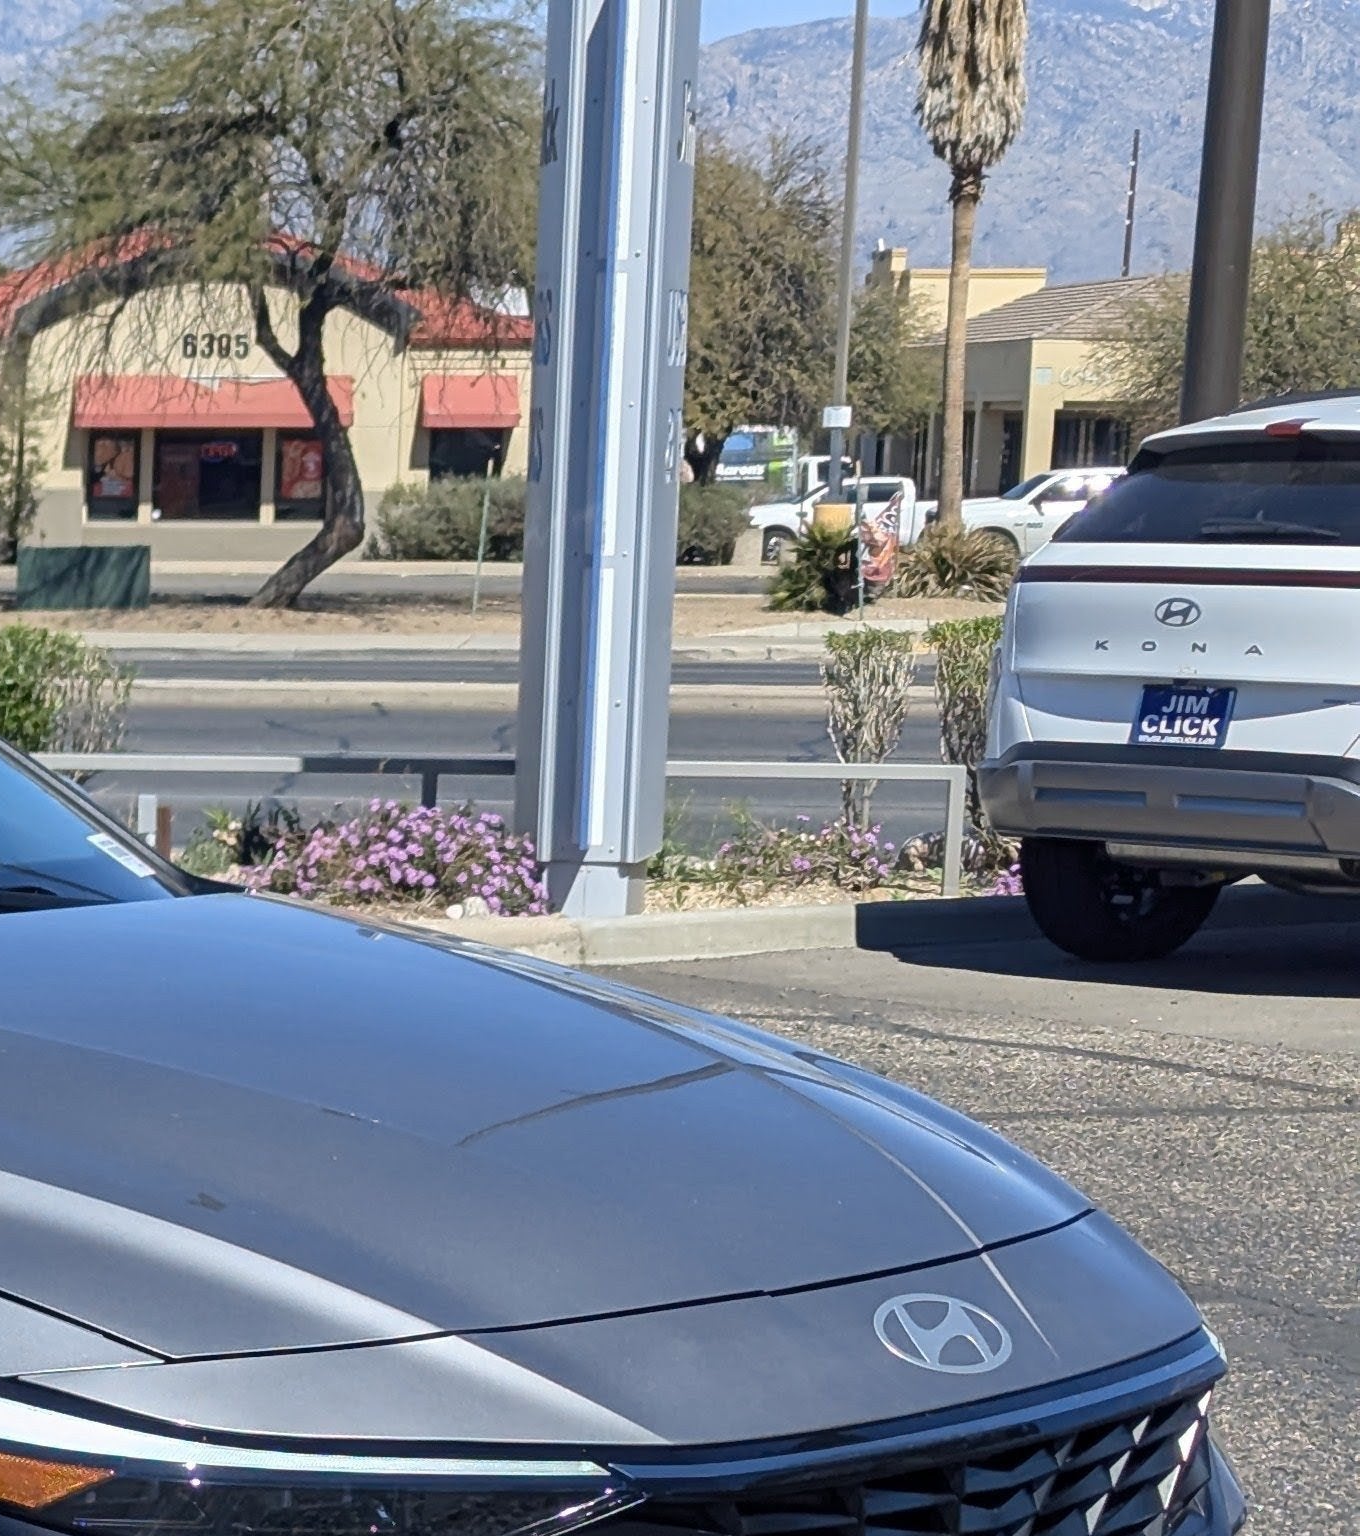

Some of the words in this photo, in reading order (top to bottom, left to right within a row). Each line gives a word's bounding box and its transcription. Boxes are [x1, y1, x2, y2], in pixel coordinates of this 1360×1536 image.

[1094, 639, 1263, 656] KONA
[1161, 694, 1210, 715] JIM
[1141, 714, 1221, 737] CLICK
